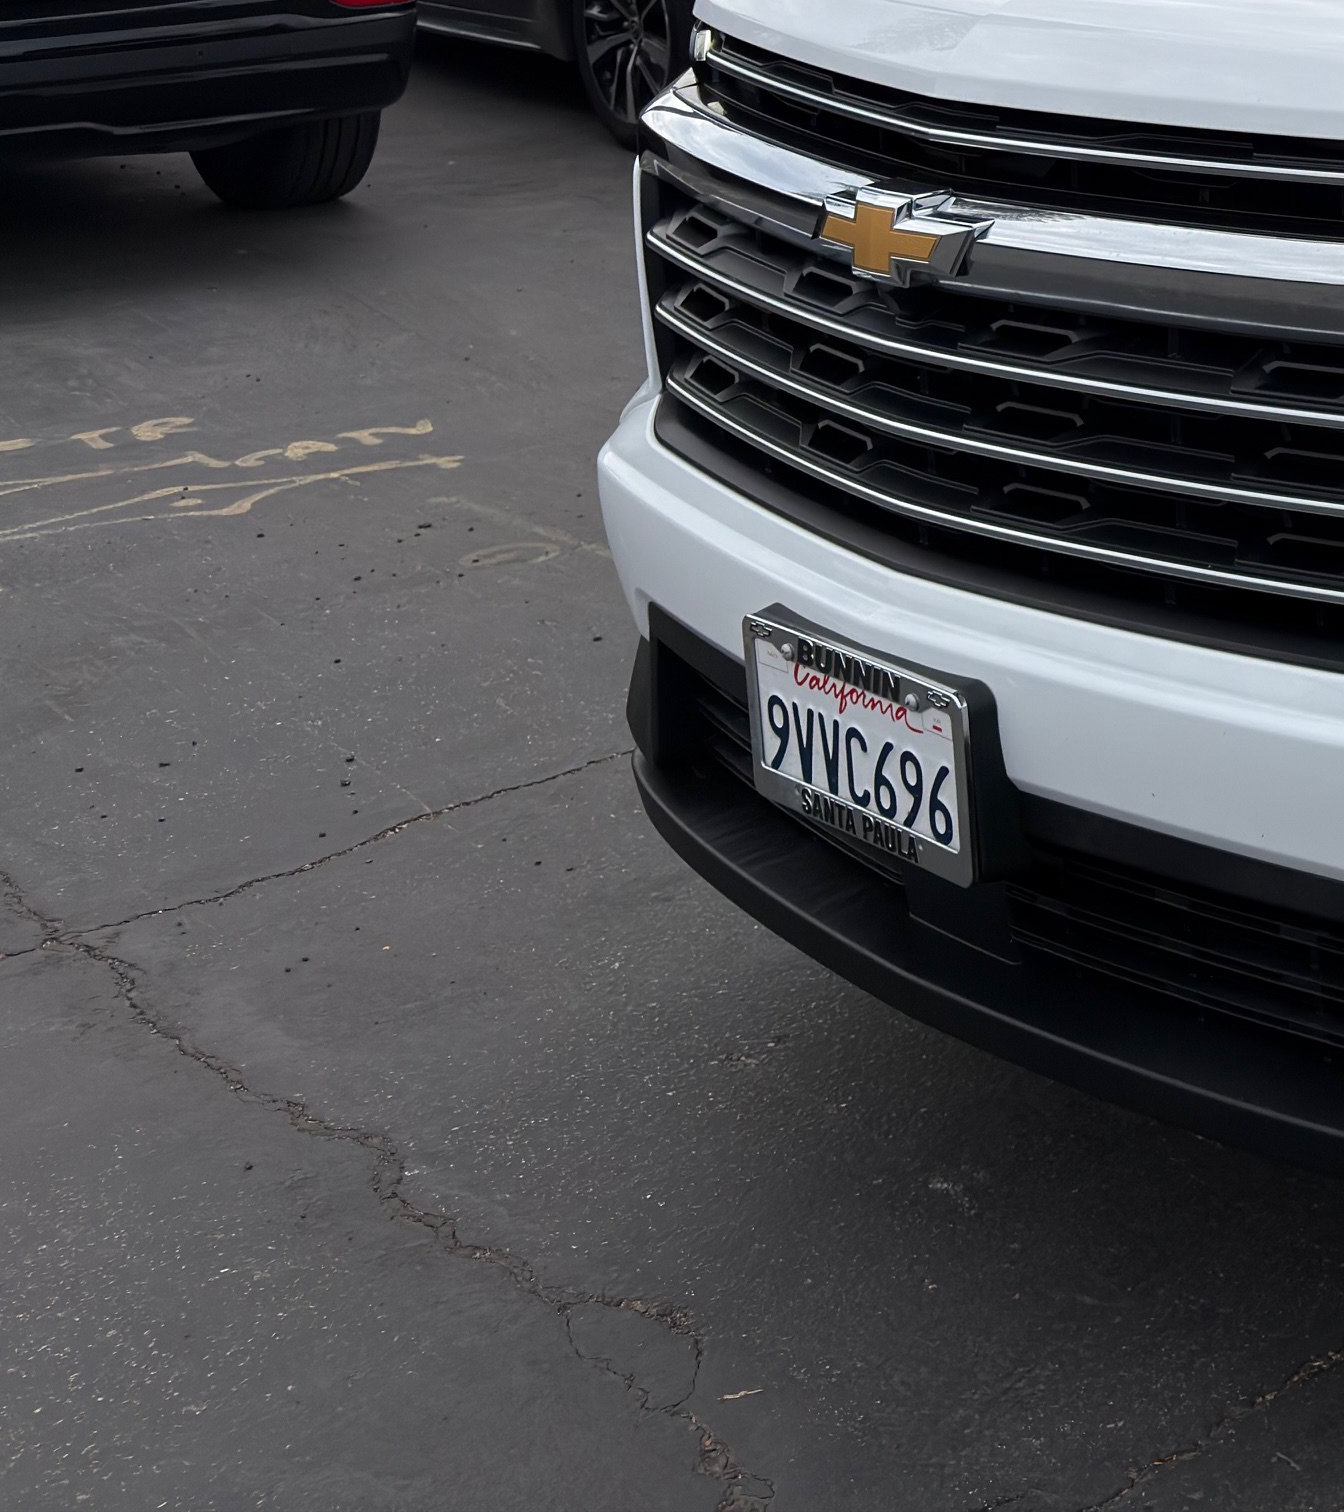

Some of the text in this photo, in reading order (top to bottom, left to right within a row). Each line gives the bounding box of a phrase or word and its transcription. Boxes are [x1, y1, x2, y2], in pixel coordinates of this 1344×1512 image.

[793, 664, 924, 734] California
[797, 637, 901, 702] BUNNIN
[767, 694, 954, 846] 9VVC696
[801, 788, 920, 863] SANTA PAULA
